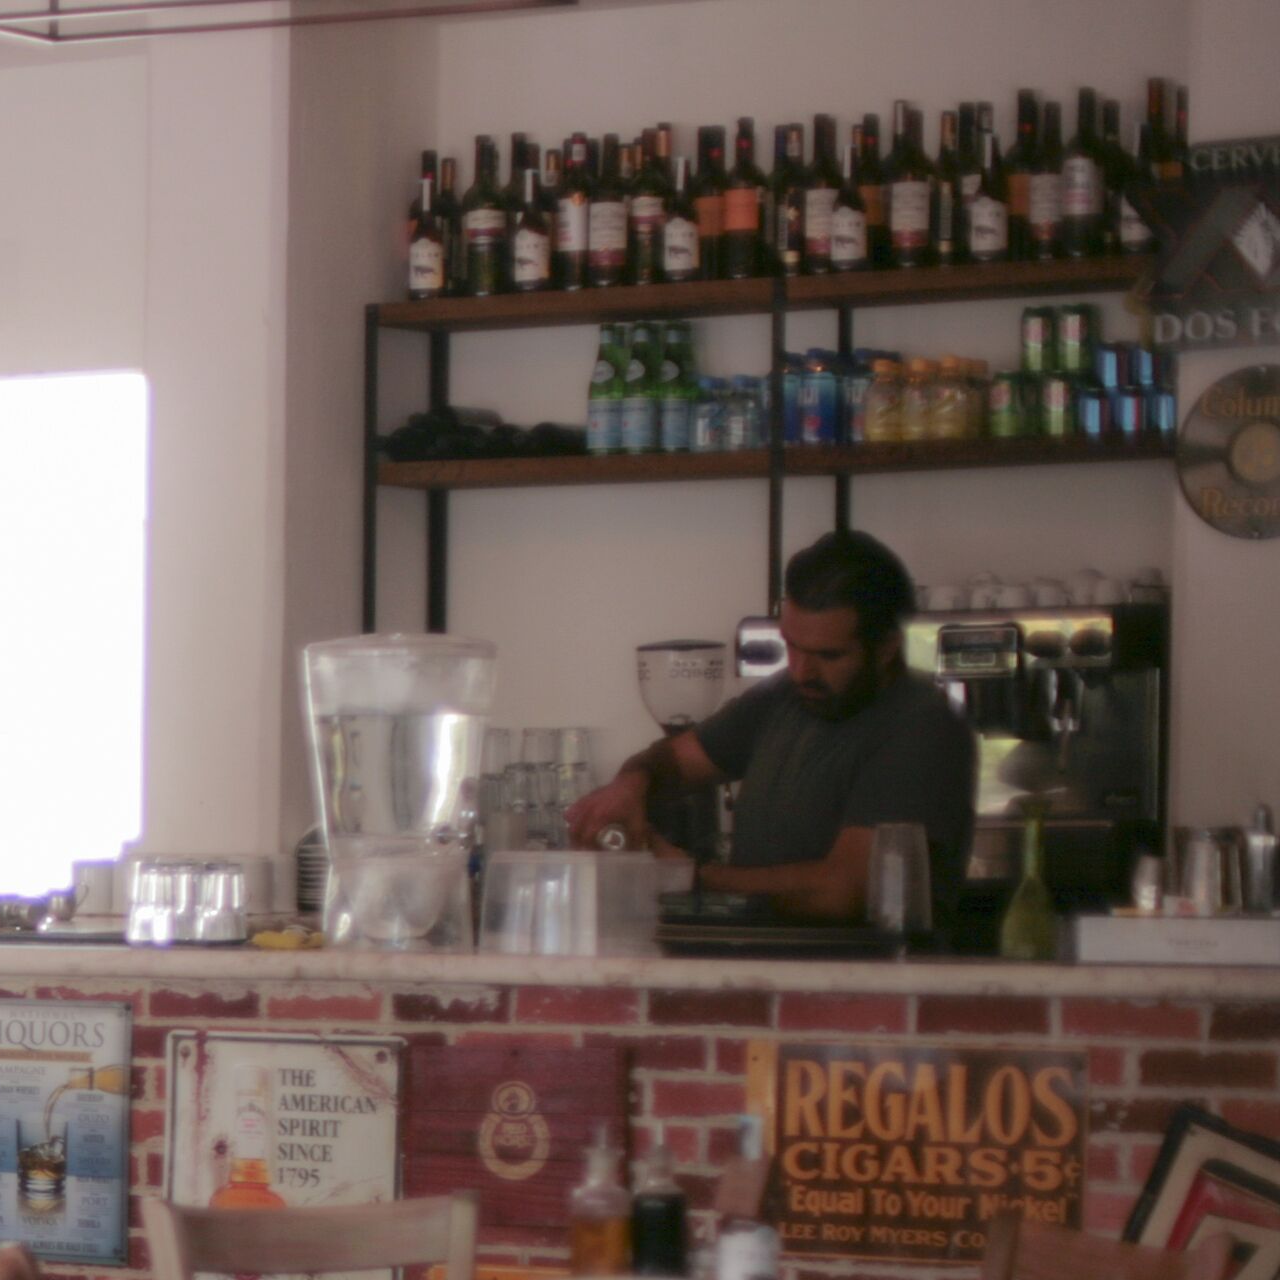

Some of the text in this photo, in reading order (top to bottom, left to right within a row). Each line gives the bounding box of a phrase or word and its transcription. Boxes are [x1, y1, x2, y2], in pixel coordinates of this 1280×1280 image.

[1154, 310, 1236, 344] DOS
[277, 1068, 317, 1088] THE
[277, 1095, 378, 1115] AMERICAN
[784, 1059, 1078, 1147] REGALOS
[277, 1117, 342, 1139] SPIRIT
[276, 1143, 334, 1164] SINCE
[782, 1141, 1009, 1188] CIGARS
[276, 1166, 321, 1188] 1795
[871, 1189, 902, 1214] To
[907, 1190, 972, 1220] Your
[778, 1221, 817, 1241] LEE
[822, 1223, 865, 1243] ROY
[869, 1225, 948, 1247] MYERS
